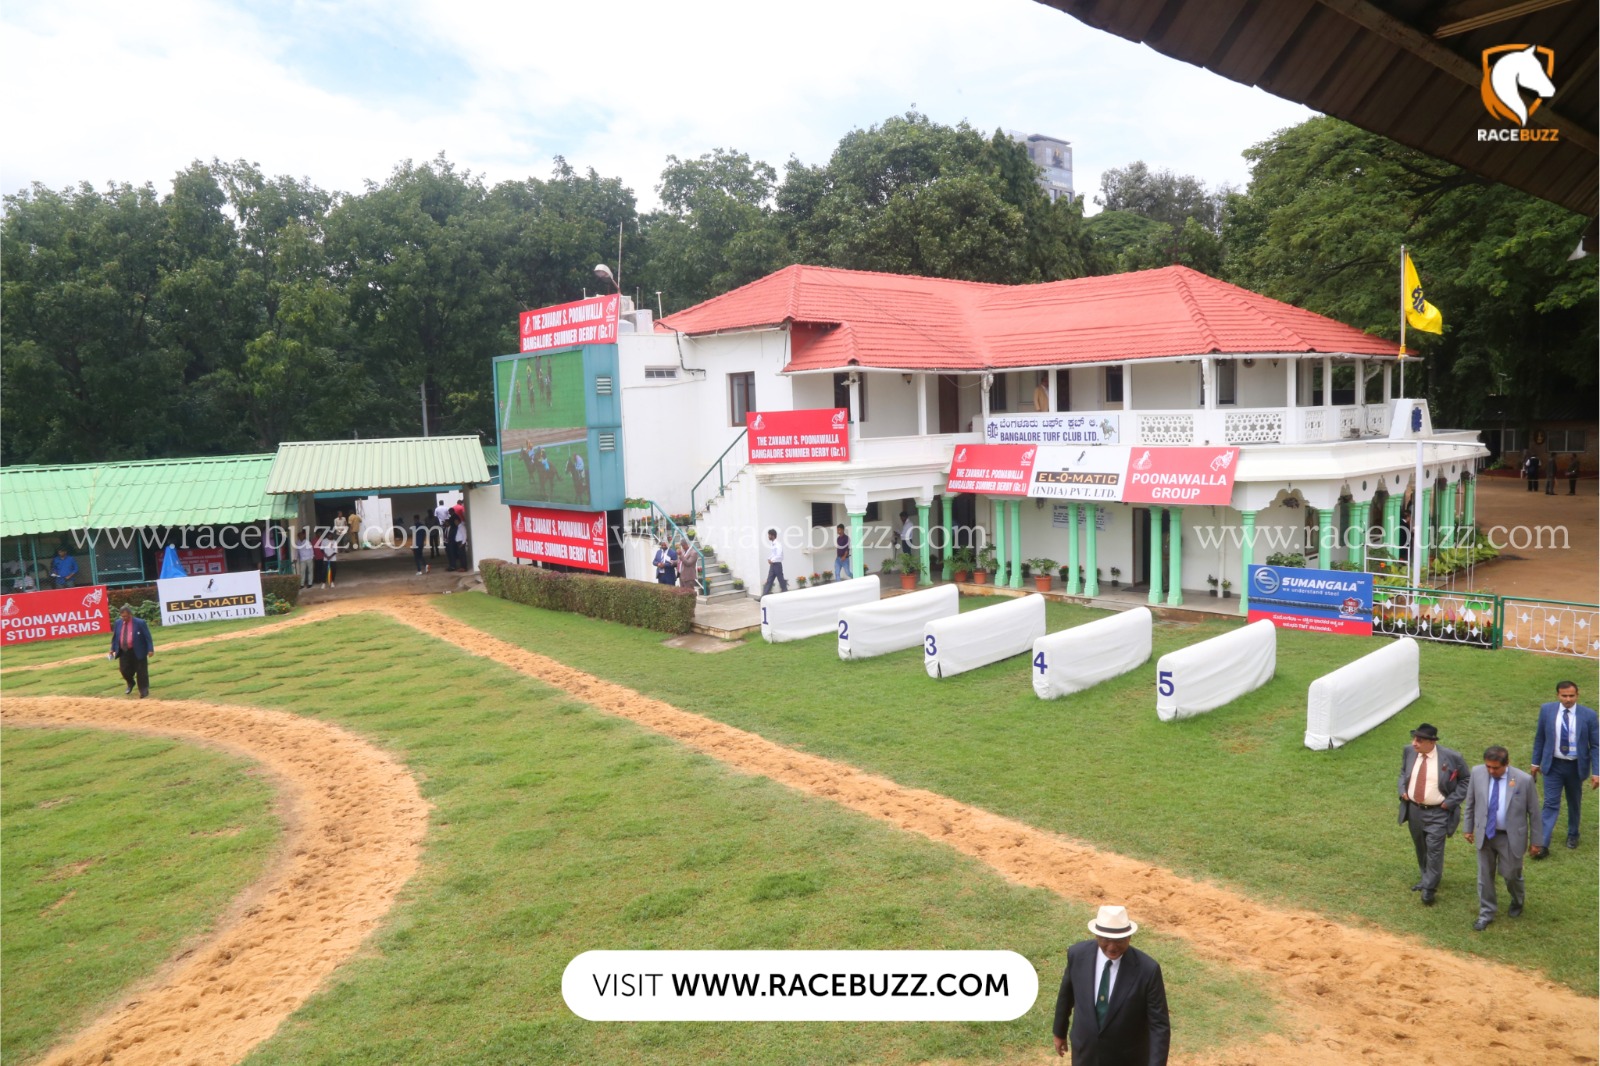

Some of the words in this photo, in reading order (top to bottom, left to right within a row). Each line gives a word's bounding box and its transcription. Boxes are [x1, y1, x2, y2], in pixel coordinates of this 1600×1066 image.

[532, 315, 541, 330] THE
[569, 302, 603, 324] POONAWALLA
[523, 333, 552, 351] BANGALORE
[554, 329, 578, 346] SUMMER
[578, 325, 597, 342] DERBY
[756, 436, 767, 446] THE
[768, 435, 792, 446] ZAVARAY
[794, 435, 800, 445] S.
[800, 434, 840, 445] POONAWALLA
[1000, 432, 1040, 442] BANGALORE
[1043, 432, 1061, 442] TURF
[1062, 432, 1082, 442] CLUB
[1084, 432, 1100, 442] LTD.
[752, 448, 784, 459] BANGALORE
[784, 447, 810, 458] SUMMER
[811, 447, 829, 457] DERBY
[956, 468, 966, 478] THE
[991, 469, 1024, 480] POONAWALLA
[1132, 473, 1227, 486] POONAWALLA
[948, 480, 975, 490] BANGALORE
[975, 480, 996, 491] SUMMER
[996, 482, 1012, 492] DERBY
[1032, 486, 1068, 496] (INDIA)
[1070, 488, 1092, 497] PVT.
[1094, 489, 1117, 498] LTD.
[1152, 487, 1200, 499] GROUP
[524, 516, 532, 532] THE
[558, 520, 590, 540] POONAWALLA
[515, 538, 544, 556] BANGALORE
[544, 542, 568, 559] SUMMER
[569, 545, 586, 562] DERBY
[1282, 577, 1357, 592] SUMANGALA
[1, 609, 103, 630] POONAWALLA
[168, 612, 207, 625] (INDIA)
[210, 609, 233, 619] PVT.
[235, 607, 259, 616] LTD.
[762, 607, 769, 625] 1
[6, 627, 46, 641] STUD
[51, 621, 100, 636] FARMS
[838, 620, 849, 640] 2
[926, 635, 937, 656] 3
[1034, 652, 1048, 674] 4
[1158, 671, 1174, 696] 5
